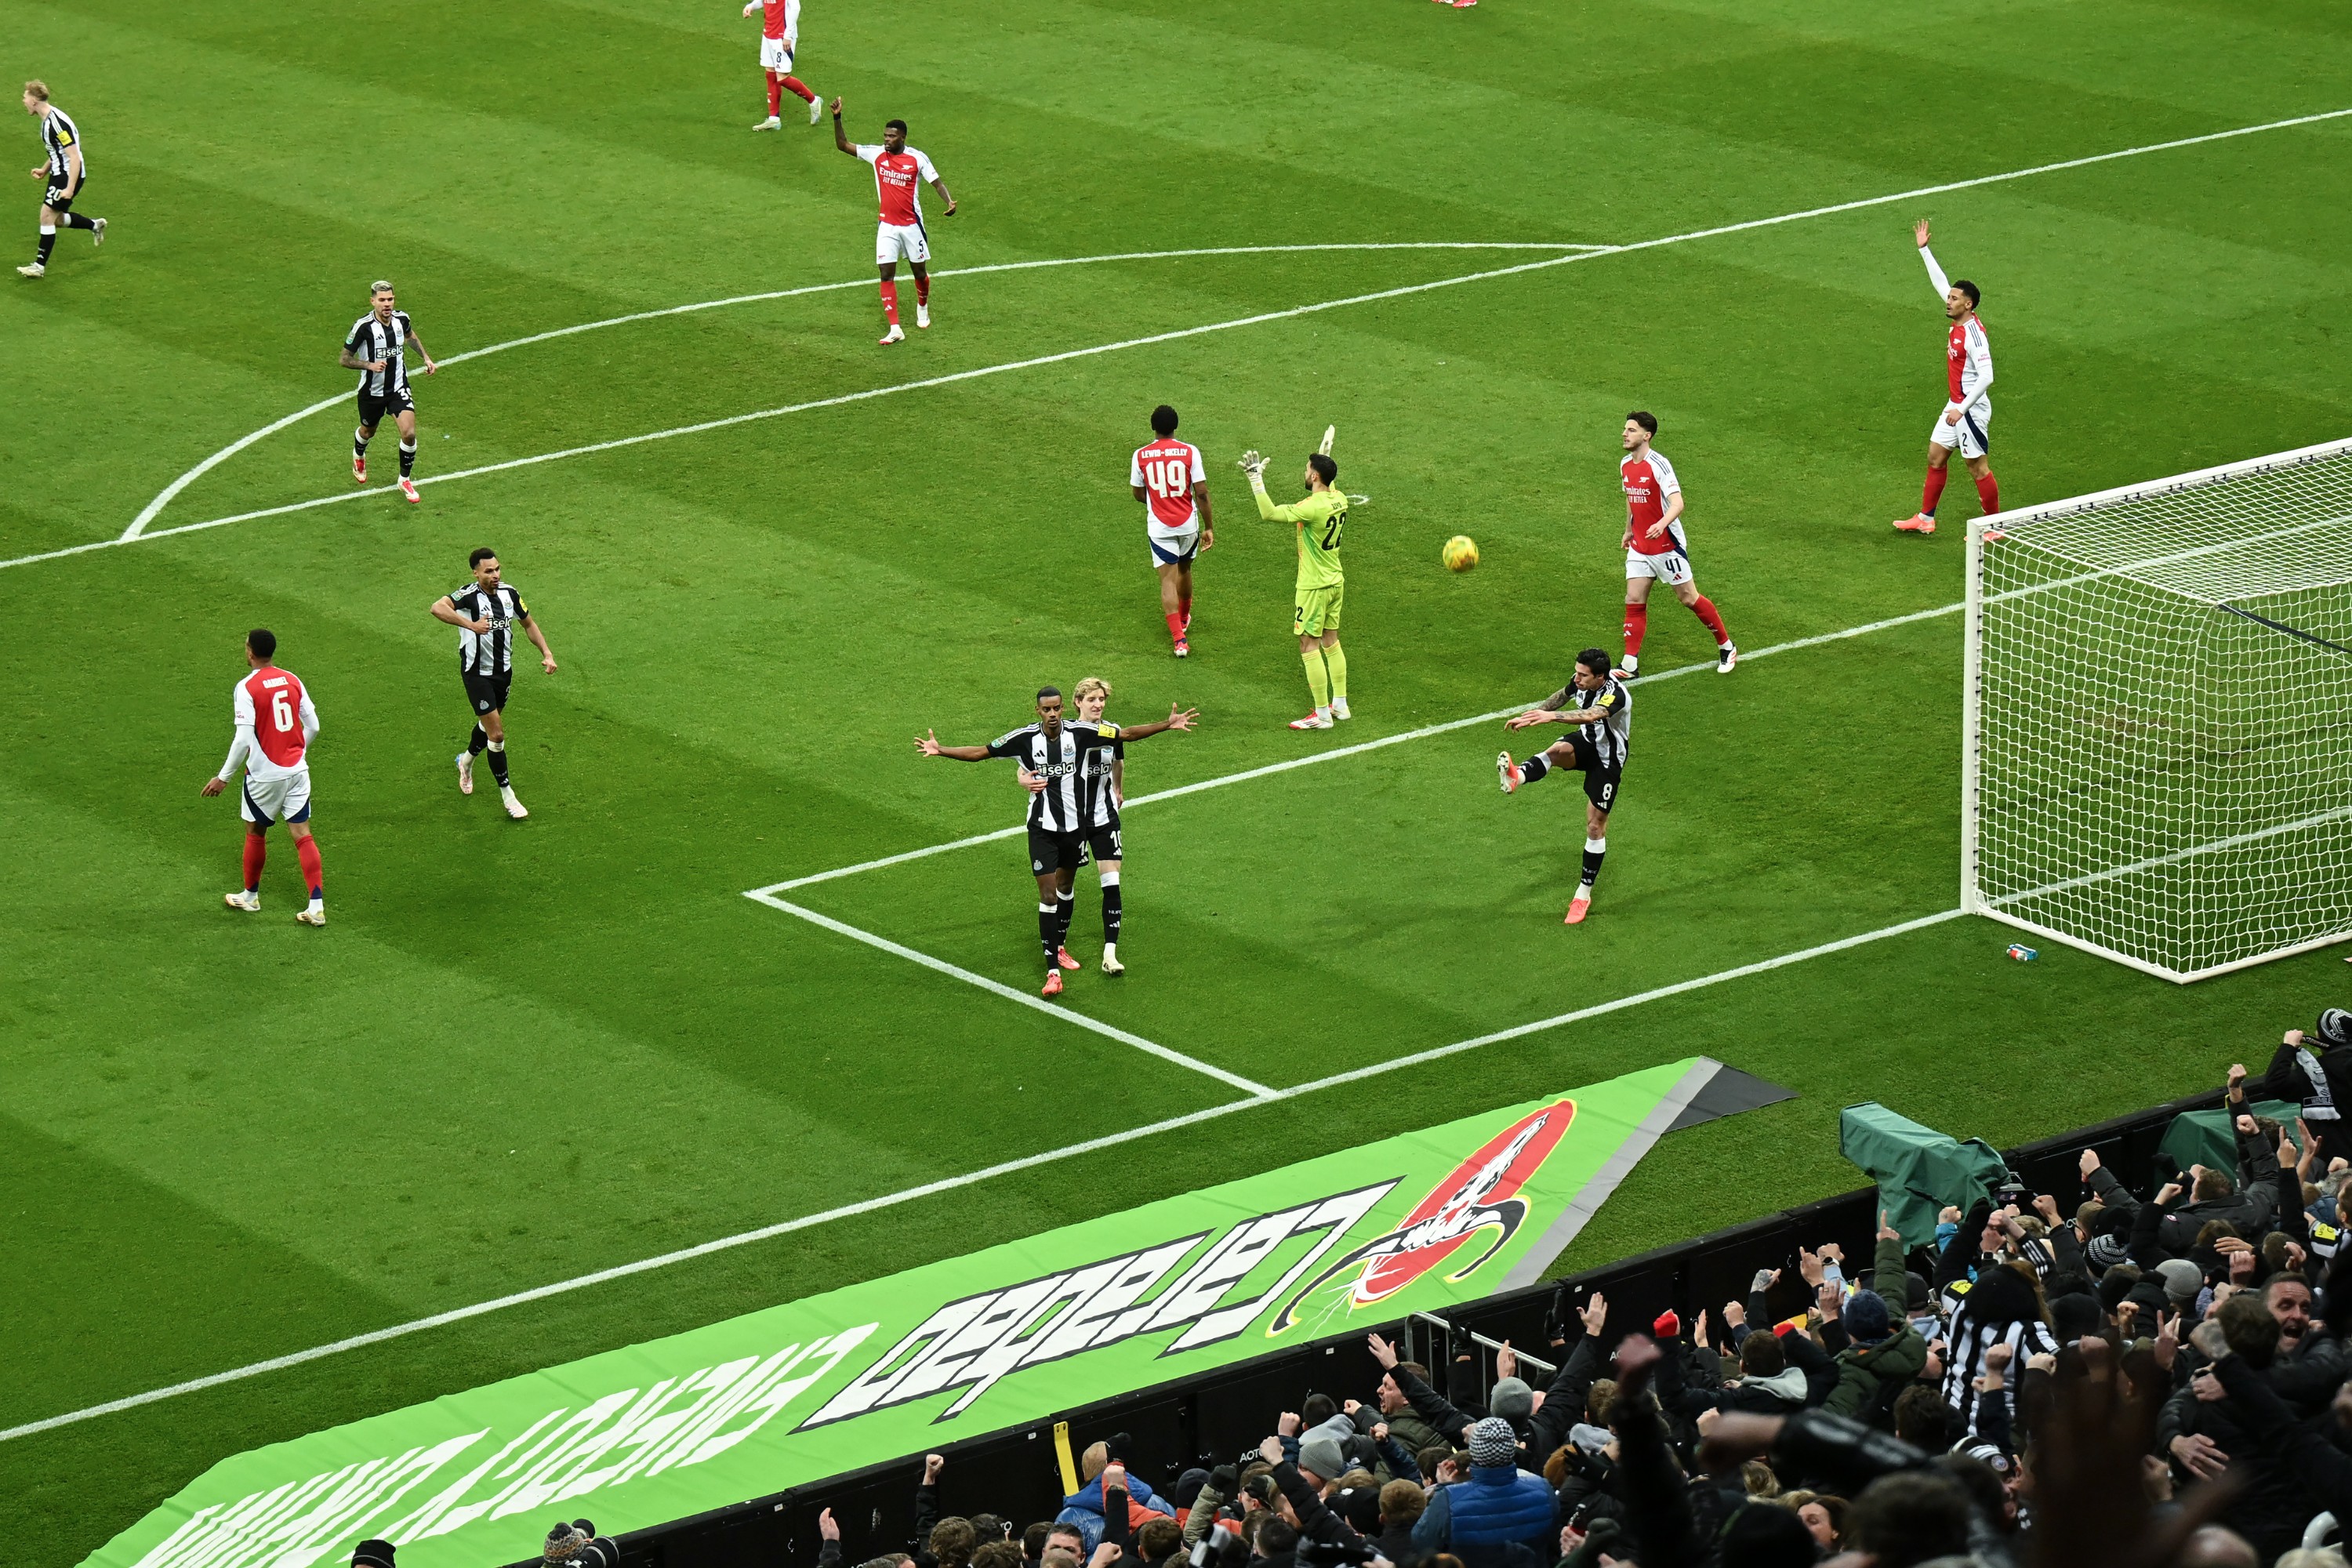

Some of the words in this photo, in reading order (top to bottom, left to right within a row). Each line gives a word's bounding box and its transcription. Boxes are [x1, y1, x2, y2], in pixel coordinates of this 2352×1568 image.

[776, 52, 782, 63] 8
[879, 166, 912, 180] Emirates
[918, 240, 924, 252] 5
[1962, 433, 1968, 447] 2
[1142, 448, 1188, 459] LEWIS-SKELLY
[1145, 460, 1186, 499] 49
[1321, 512, 1346, 550] 22
[1665, 557, 1682, 573] 41
[1295, 606, 1303, 622] 2
[272, 690, 294, 733] 6
[1048, 763, 1075, 775] sela
[1602, 783, 1613, 800] 8
[786, 1174, 1406, 1436] Carabao
[336, 1322, 880, 1563] ENERGY
